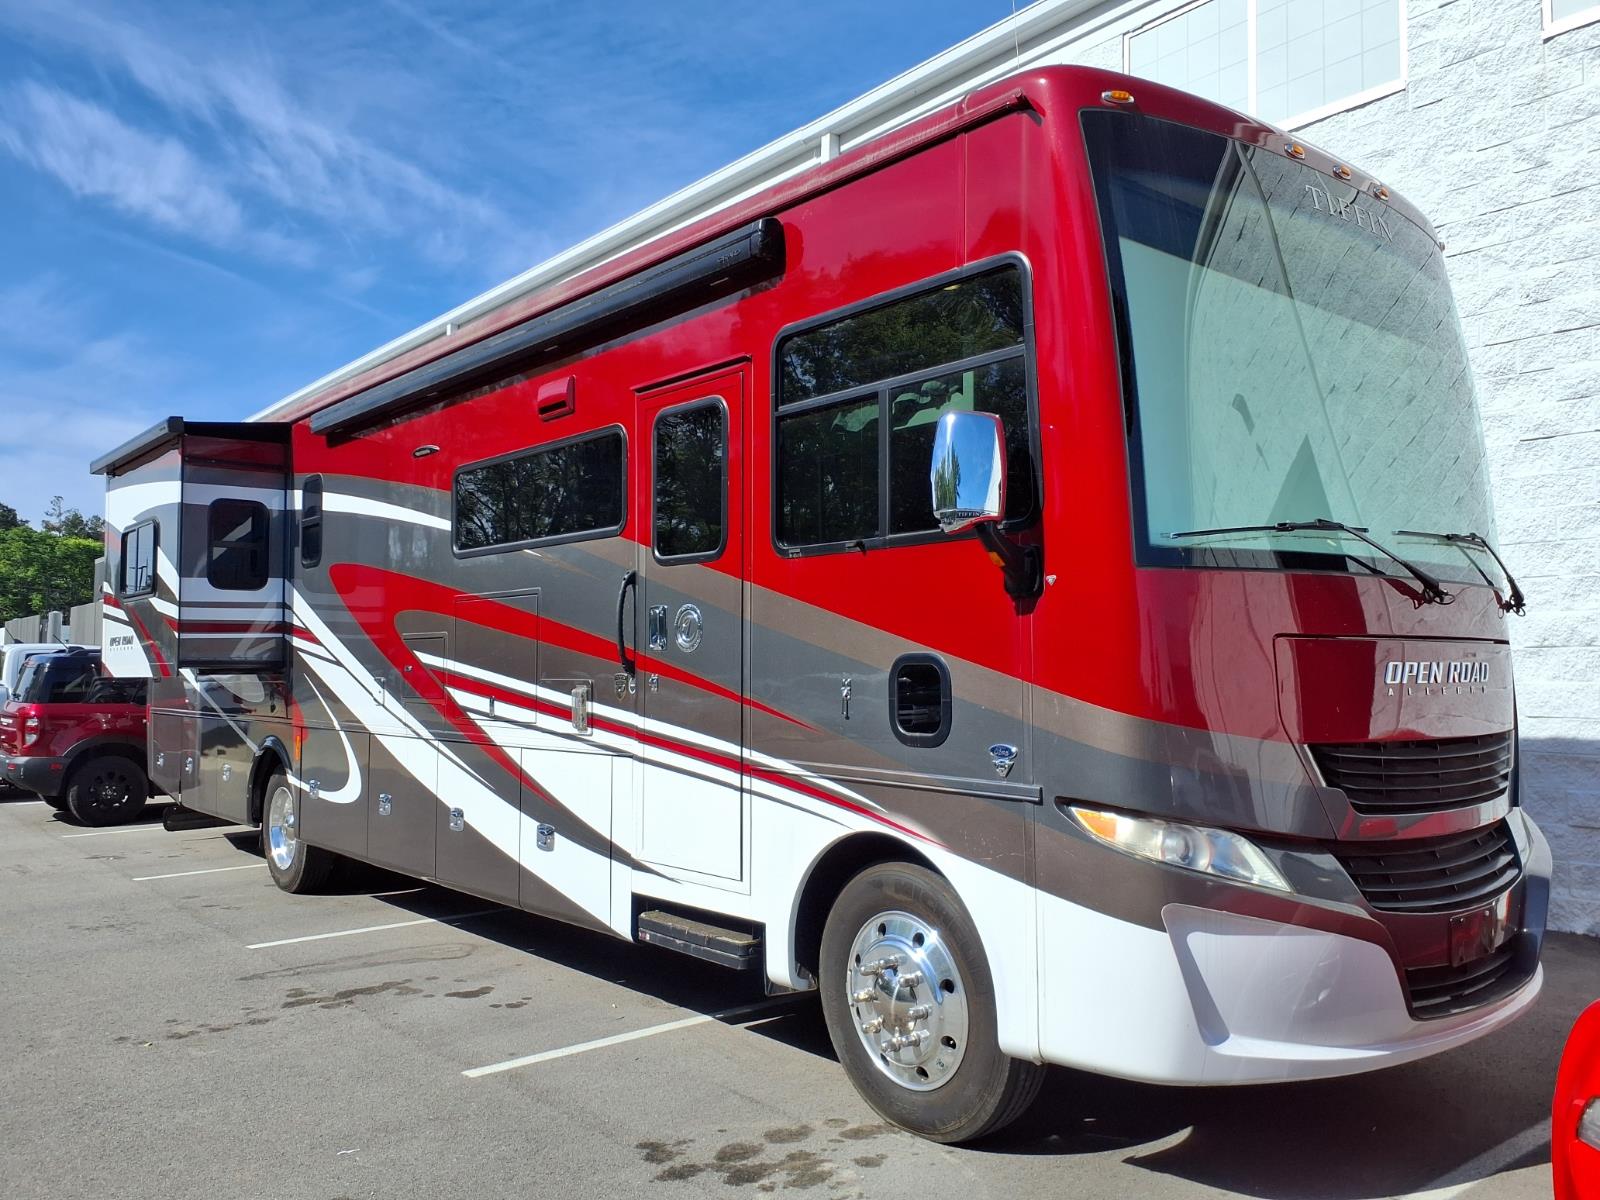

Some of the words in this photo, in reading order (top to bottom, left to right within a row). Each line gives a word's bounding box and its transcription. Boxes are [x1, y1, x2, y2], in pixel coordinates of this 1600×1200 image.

[1305, 184, 1392, 242] TIFFIN
[1385, 661, 1444, 684] OPEN
[1448, 661, 1490, 683] ROAD
